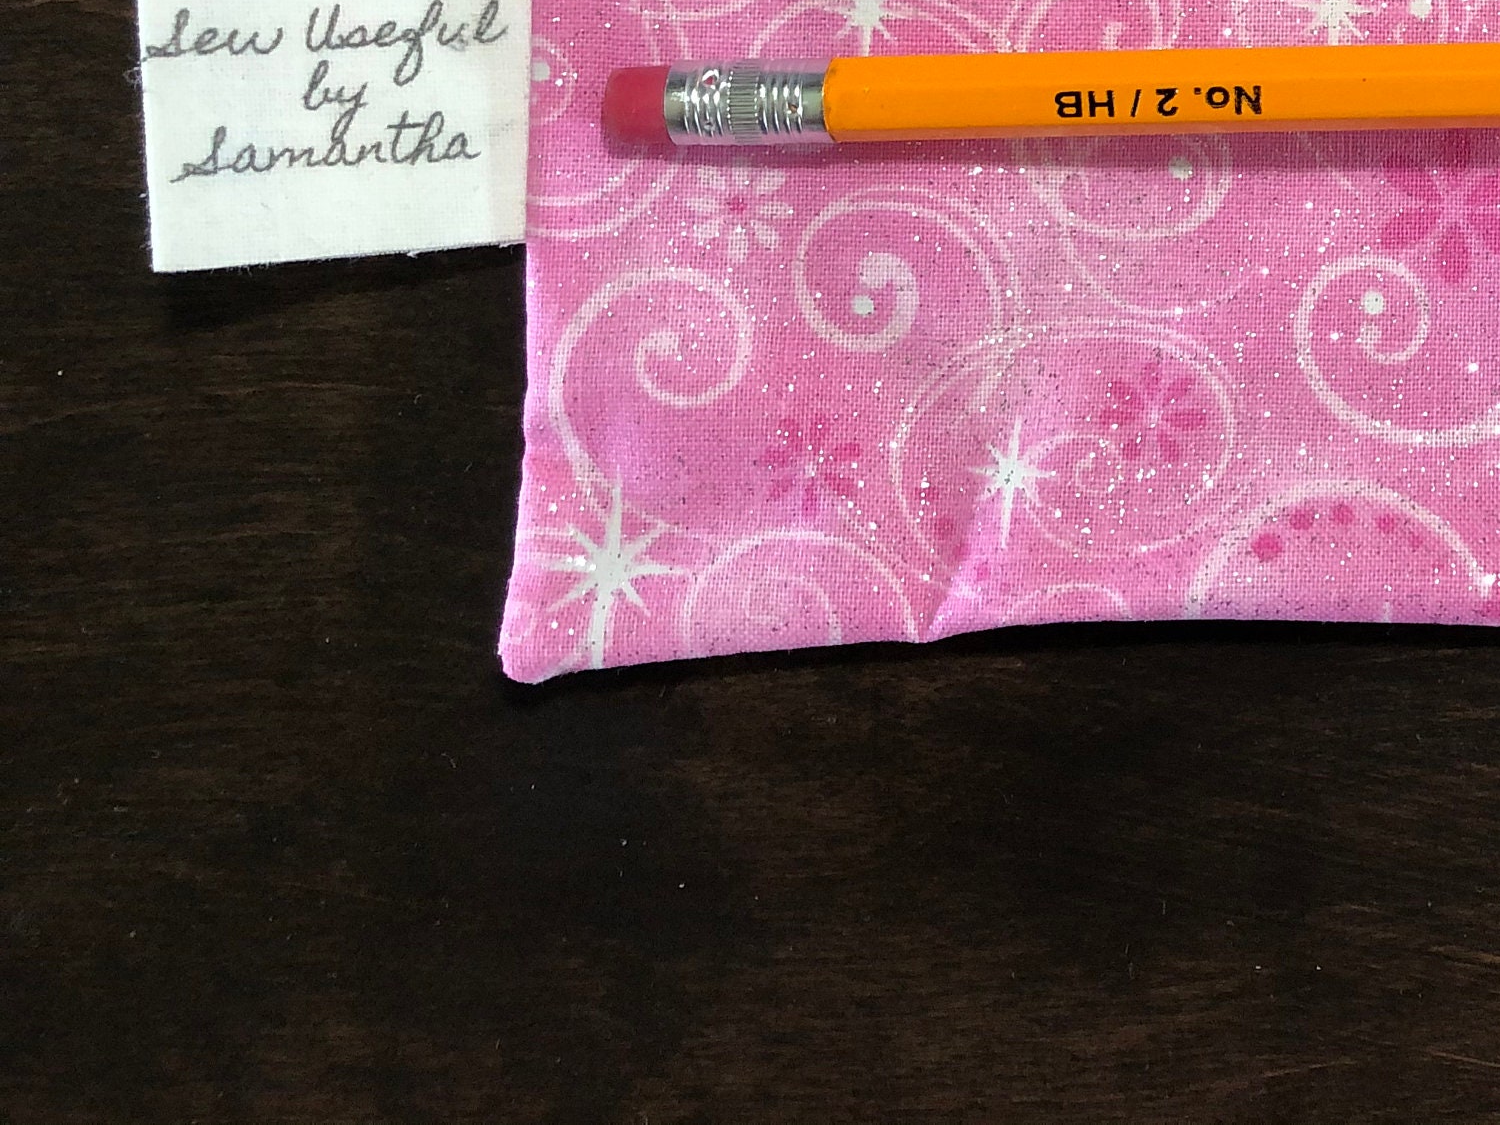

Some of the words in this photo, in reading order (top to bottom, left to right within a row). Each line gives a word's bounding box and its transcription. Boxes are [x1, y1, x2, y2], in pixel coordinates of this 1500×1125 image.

[140, 7, 285, 63] Sew
[301, 59, 370, 145] by
[1054, 90, 1116, 118] HB
[1130, 88, 1142, 118] /
[1155, 87, 1179, 117] 2
[1193, 85, 1263, 116] No.
[169, 110, 483, 184] Samantha
